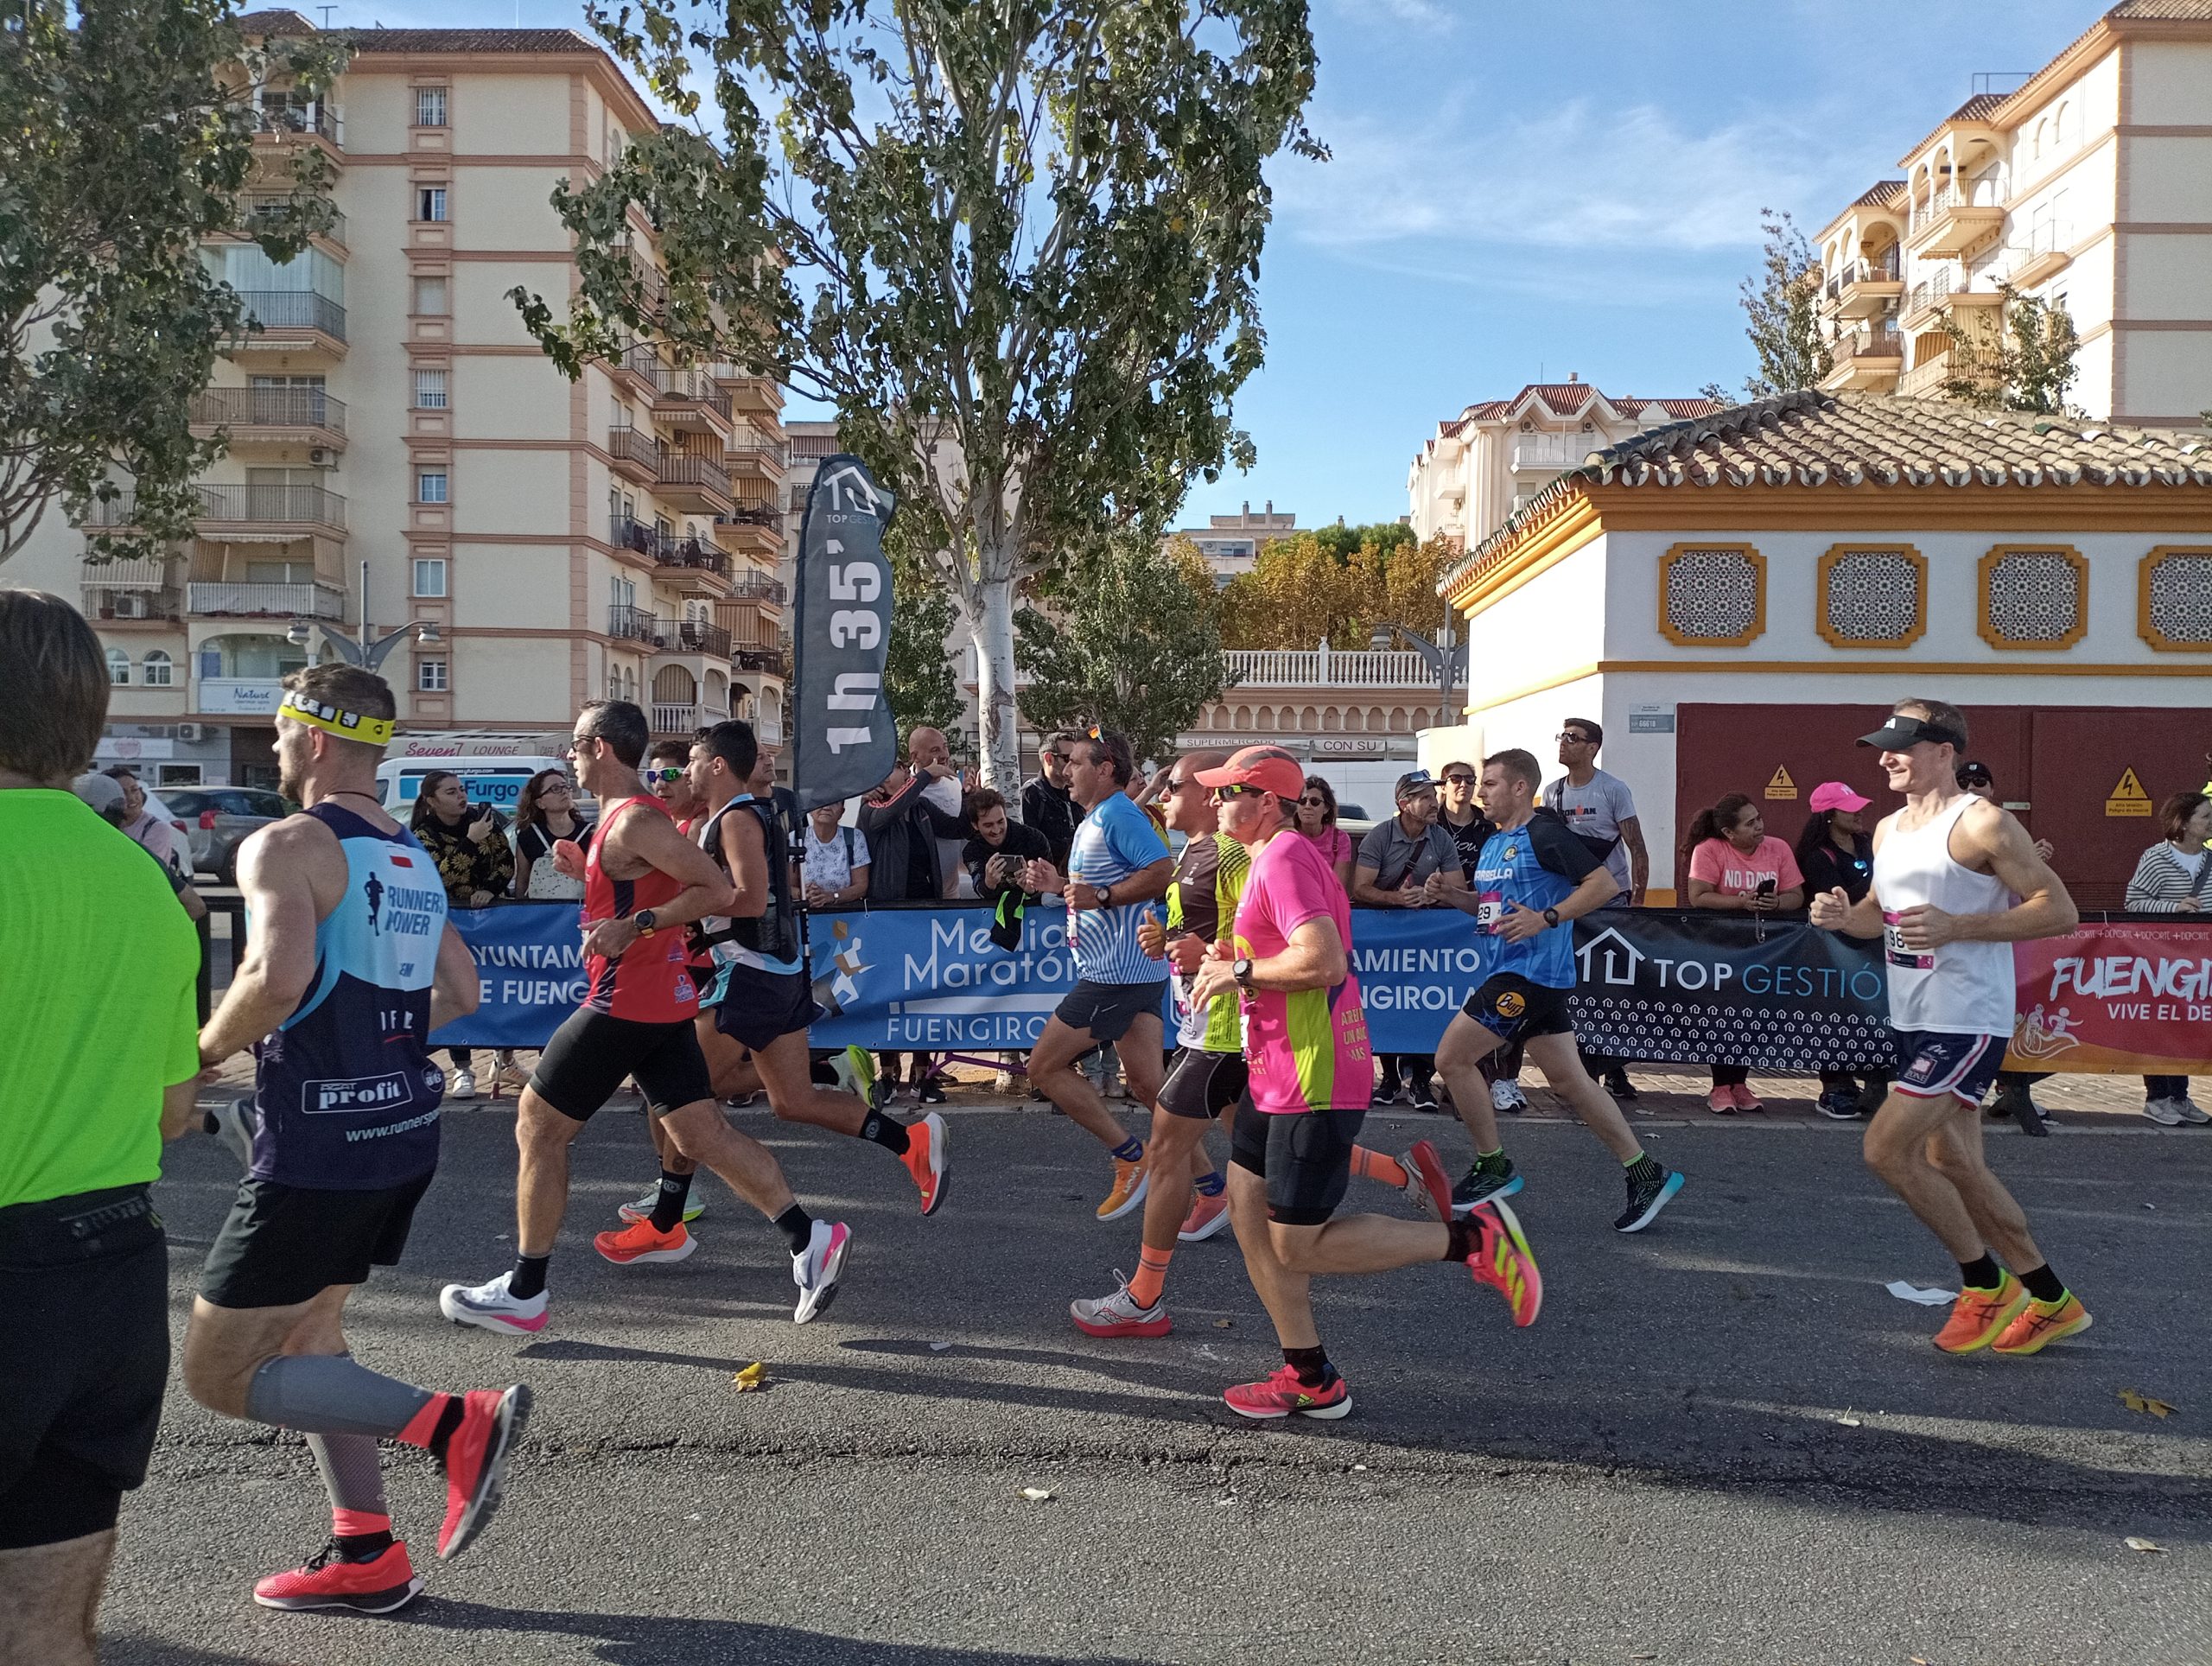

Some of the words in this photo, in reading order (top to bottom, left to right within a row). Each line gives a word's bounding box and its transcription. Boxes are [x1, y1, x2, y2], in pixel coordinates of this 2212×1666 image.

[826, 515, 848, 524] TOP
[233, 688, 270, 698] Nature
[473, 746, 518, 755] LOUNGE
[1186, 738, 1276, 747] SUPERMERCADO
[1323, 741, 1353, 751] CON
[1357, 741, 1377, 751] SU
[1473, 868, 1514, 882] ARBELLA
[1724, 868, 1742, 888] NO
[387, 885, 443, 914] RUNNERS
[385, 909, 431, 936] POWER
[931, 917, 1067, 956] Meia
[471, 944, 585, 969] YUNTAM
[1653, 958, 1733, 992] TOP
[1742, 962, 1882, 1001] GESTIÓ
[2049, 956, 2212, 1002] FUENGI
[2107, 1002, 2151, 1020] VIVE
[2157, 1003, 2181, 1021] EL
[318, 1081, 402, 1110] profit
